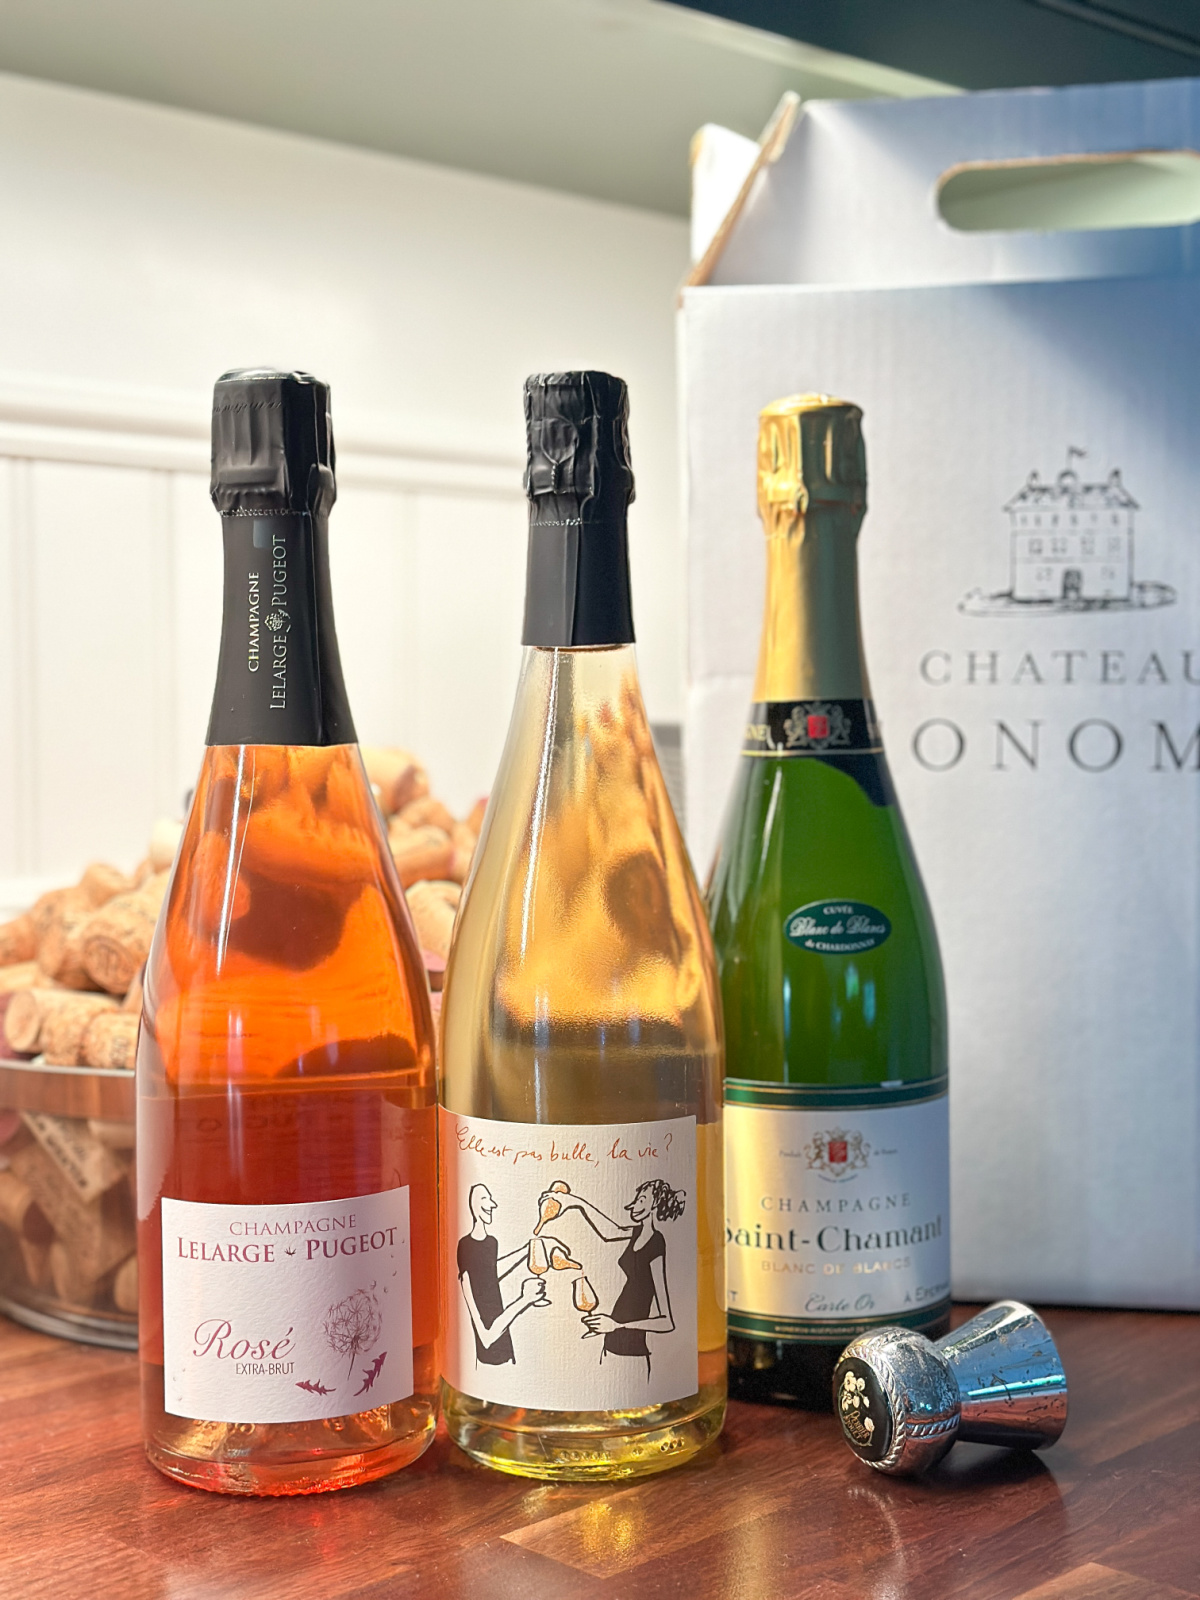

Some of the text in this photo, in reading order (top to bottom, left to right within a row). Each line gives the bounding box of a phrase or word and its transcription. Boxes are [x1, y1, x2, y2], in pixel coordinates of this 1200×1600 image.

[248, 571, 260, 673] CHAMPAGNE
[269, 534, 287, 709] LELARGE PUGEOT
[455, 1123, 487, 1157] Elle
[488, 1146, 513, 1157] est
[513, 1149, 543, 1165] pas
[550, 1140, 600, 1167] bulle,
[607, 1138, 633, 1161] la
[761, 1192, 911, 1214] CHAMPAGNE
[229, 1214, 357, 1236] CHAMPAGNE
[177, 1226, 398, 1263] LELARGE PUGEOT
[761, 1261, 816, 1276] BLANC
[823, 1262, 844, 1276] DE
[192, 1318, 297, 1360] Rosé
[235, 1361, 296, 1375] EXTRA-BRUT
